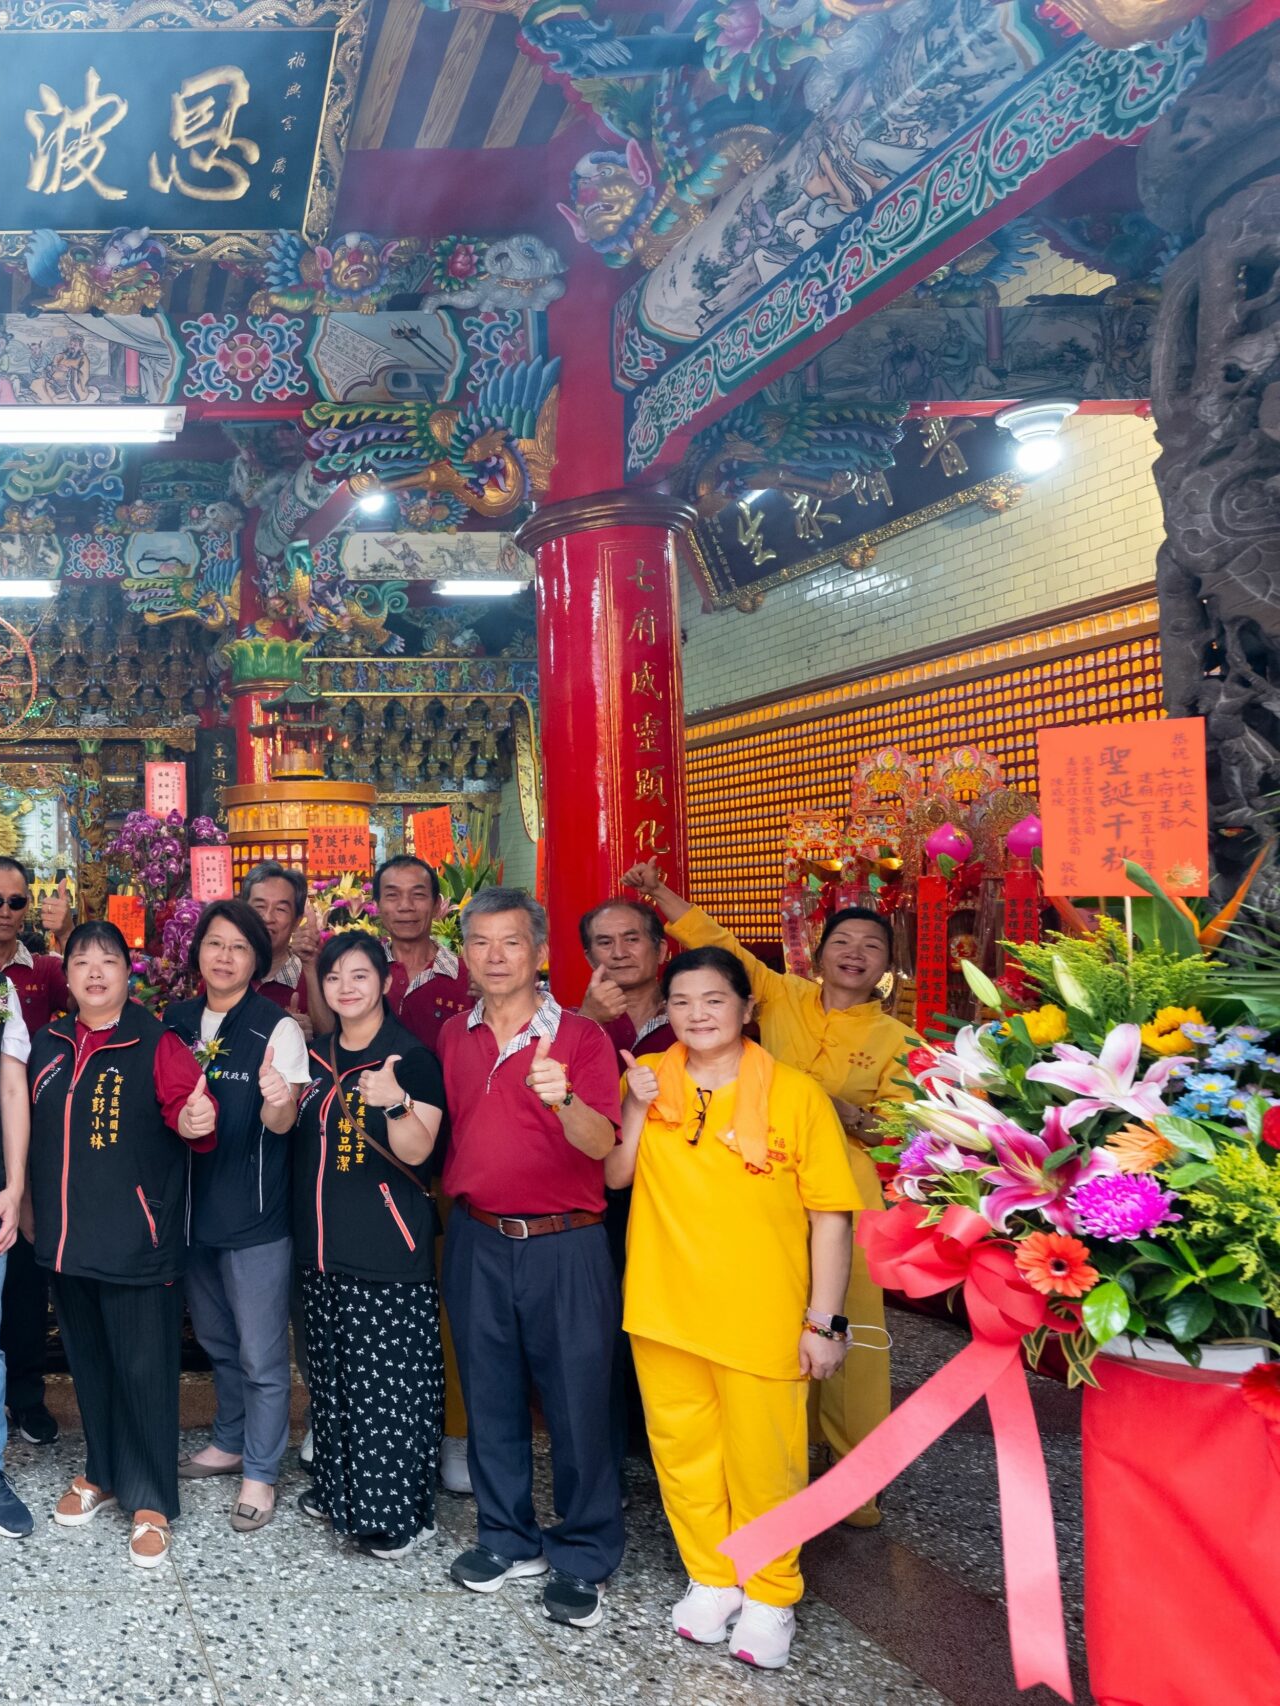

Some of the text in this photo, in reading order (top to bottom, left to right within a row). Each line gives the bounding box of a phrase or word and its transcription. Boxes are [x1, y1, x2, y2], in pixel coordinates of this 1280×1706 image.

[626, 558, 671, 906] 七府威靈顯化
[1098, 745, 1136, 873] 聖誕千秋
[1178, 767, 1198, 828] 七位夫人
[90, 1073, 107, 1150] 里長彭小林
[222, 1071, 249, 1082] 民政局
[337, 1092, 354, 1172] 里楊品潔
